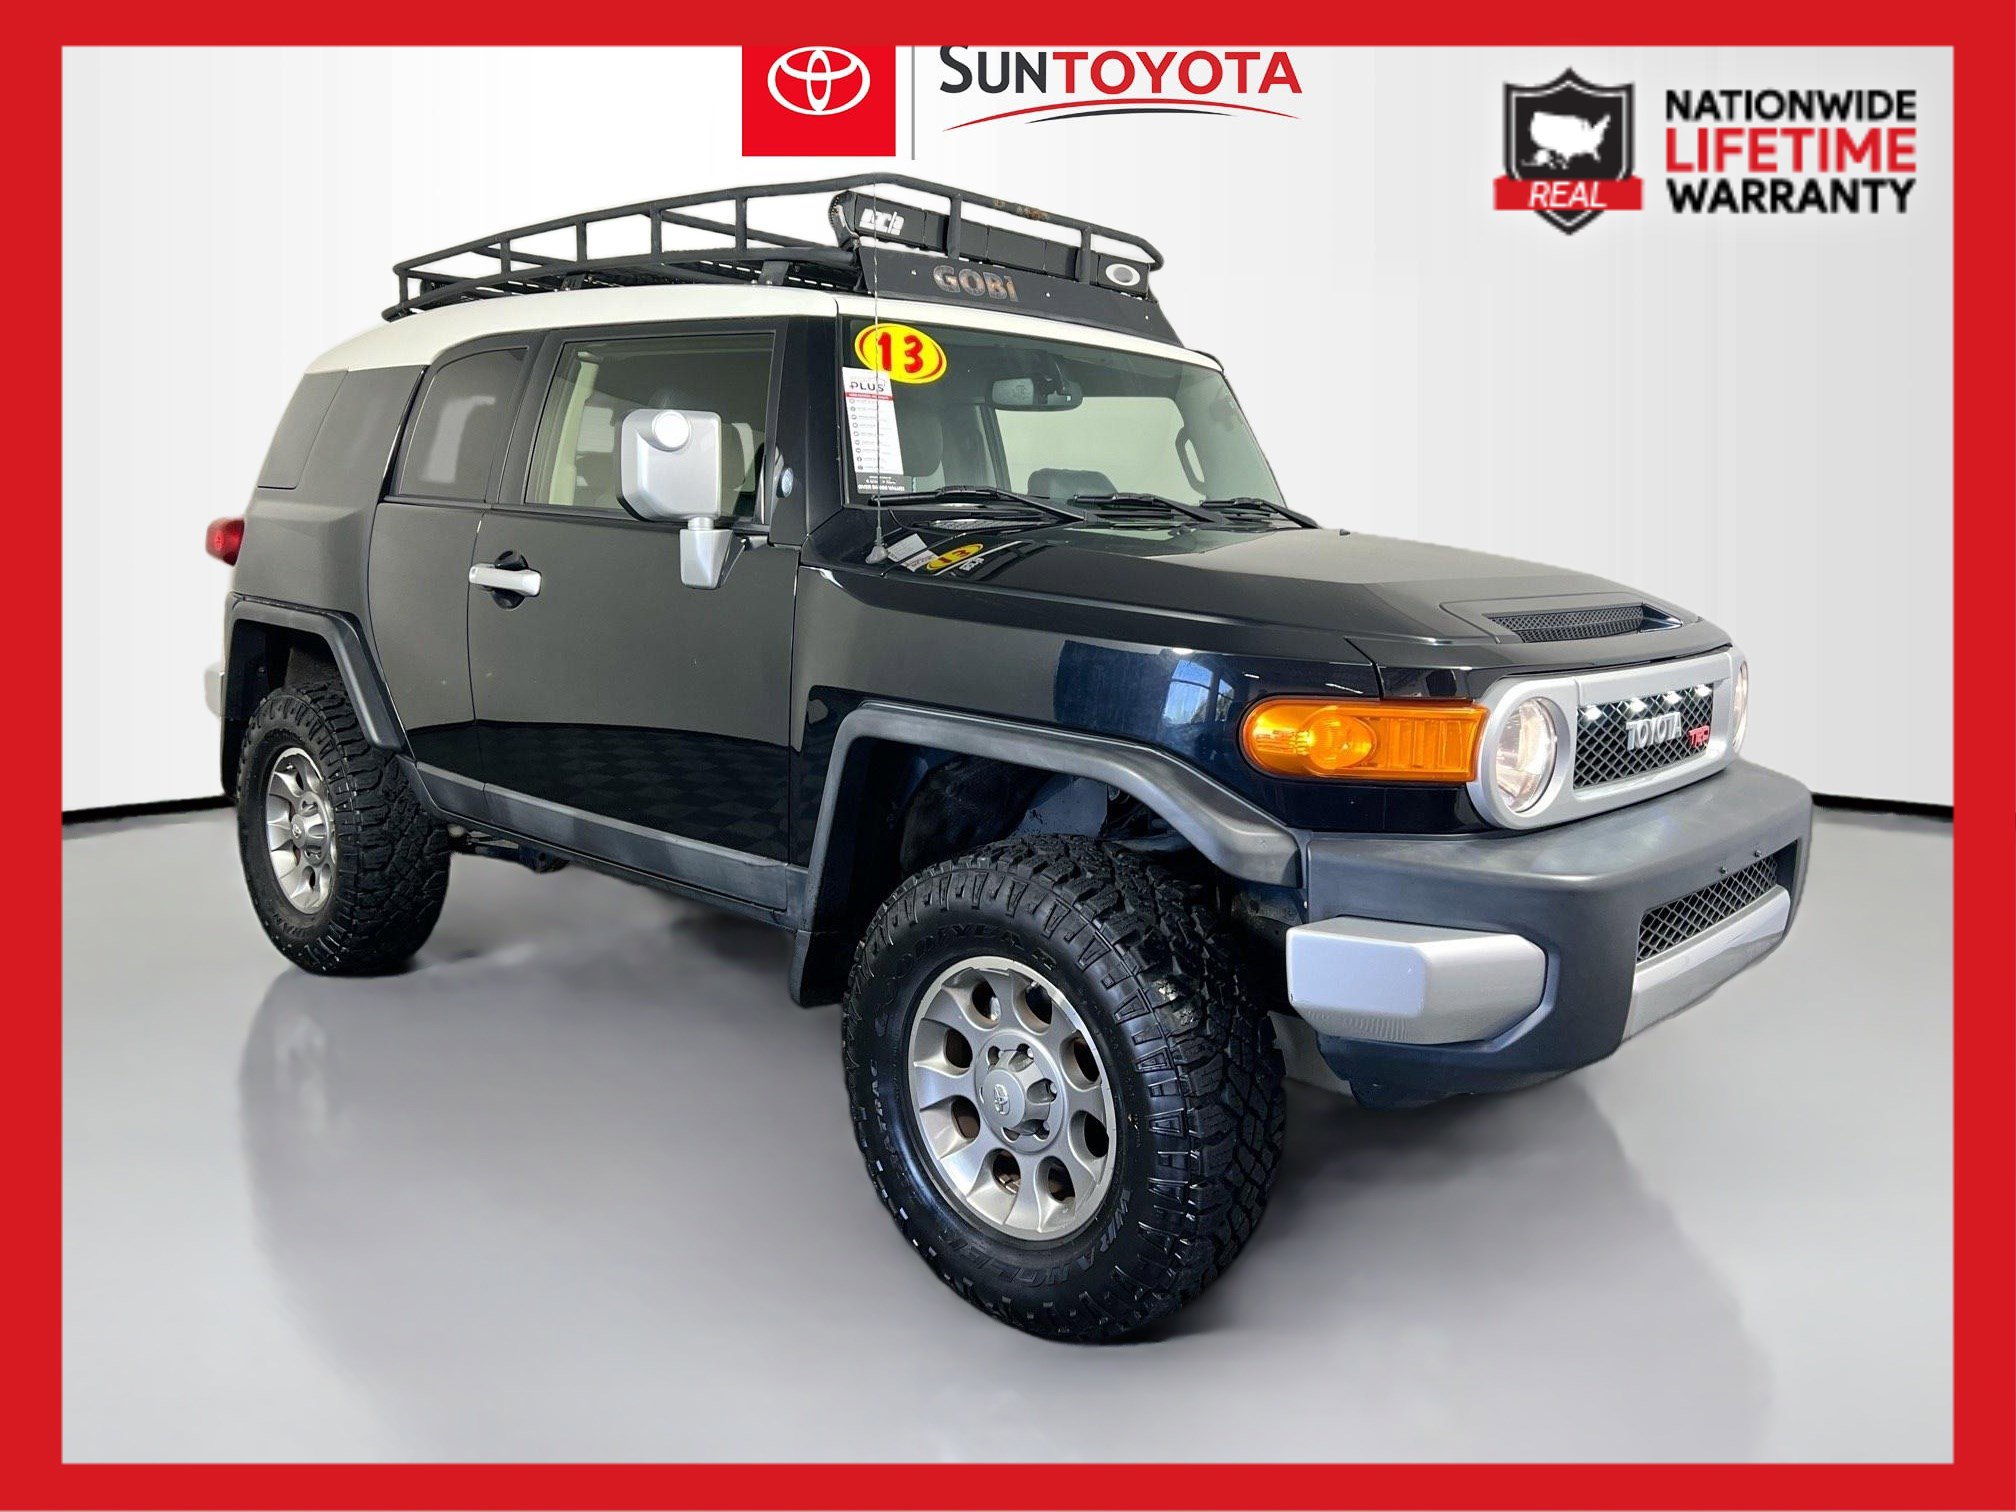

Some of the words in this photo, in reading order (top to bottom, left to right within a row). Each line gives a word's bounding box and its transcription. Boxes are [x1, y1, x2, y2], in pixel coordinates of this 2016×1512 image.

[877, 331, 923, 373] 13
[849, 381, 884, 393] PLUS
[1626, 711, 1682, 752] TOYOTA
[1688, 725, 1710, 748] TRD
[947, 1185, 1132, 1287] WRANGLER
